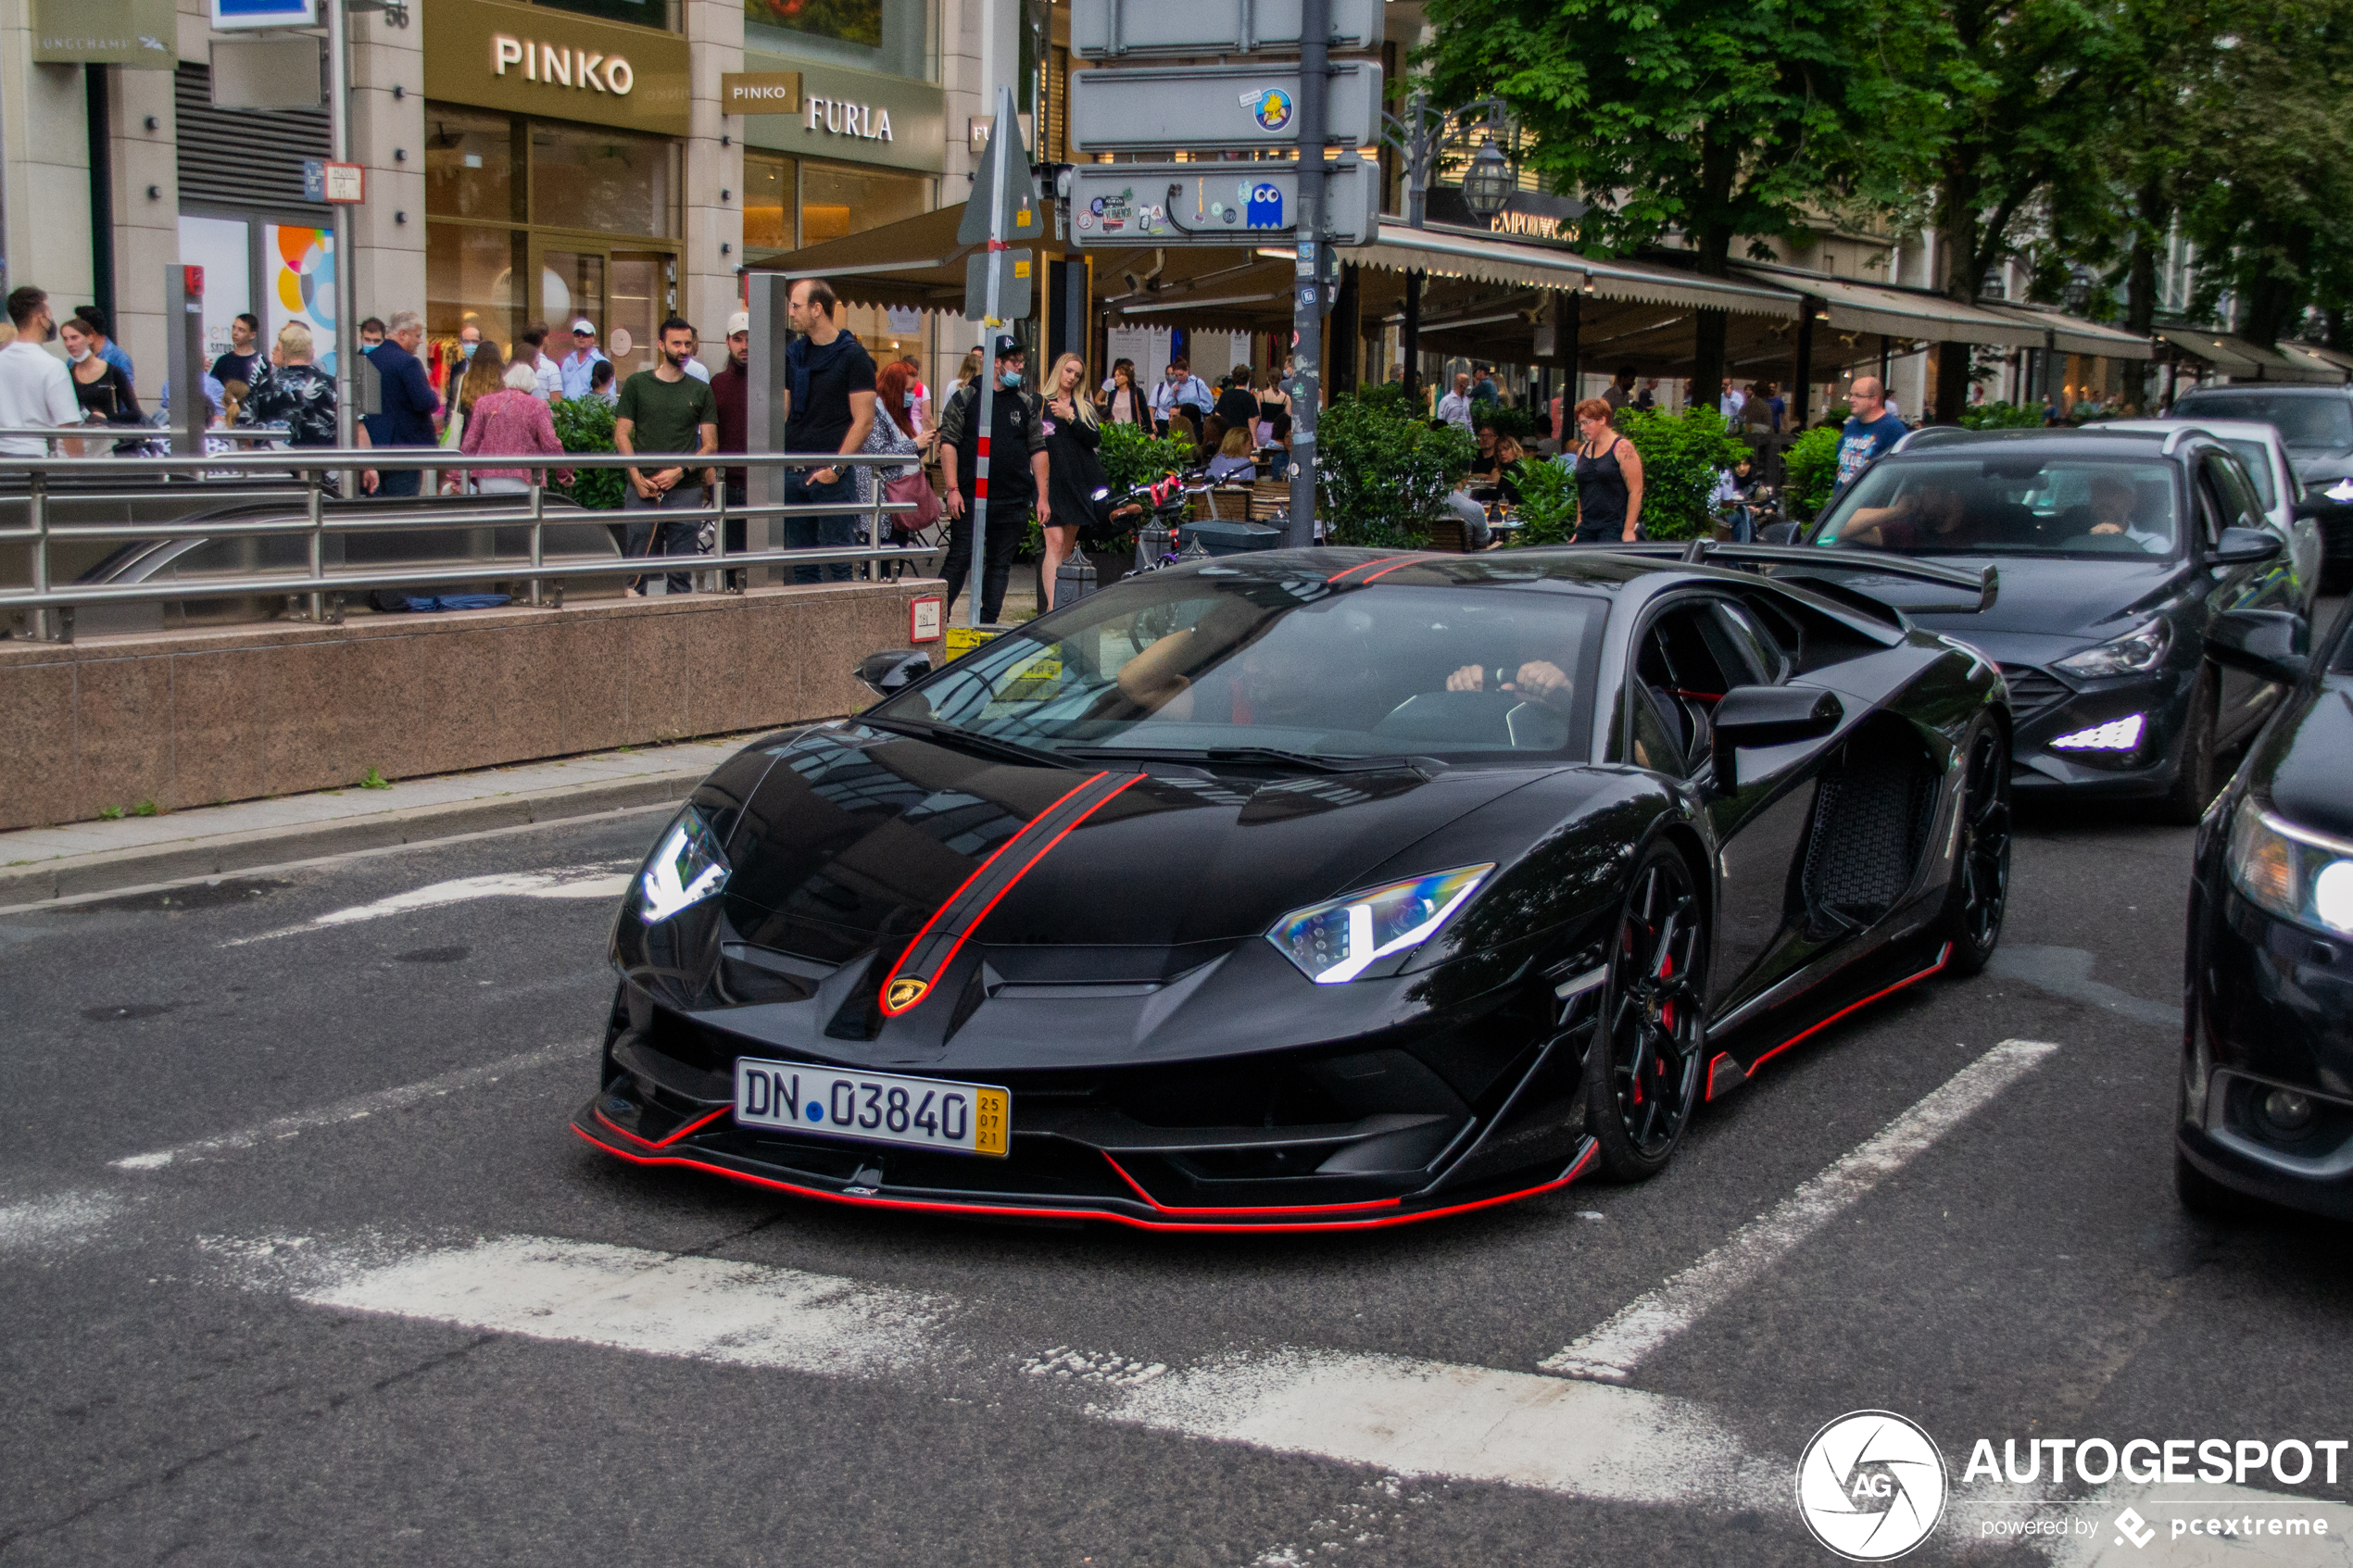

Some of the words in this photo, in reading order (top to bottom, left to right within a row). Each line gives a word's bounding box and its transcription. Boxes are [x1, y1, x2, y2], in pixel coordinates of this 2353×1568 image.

[495, 35, 635, 95] PINKO
[733, 86, 786, 100] PINKO
[805, 96, 894, 142] FURLA
[746, 1068, 800, 1120] DN
[830, 1078, 967, 1140] 03840
[980, 1097, 1000, 1110] 25
[980, 1113, 999, 1128] 07
[979, 1130, 997, 1145] 21
